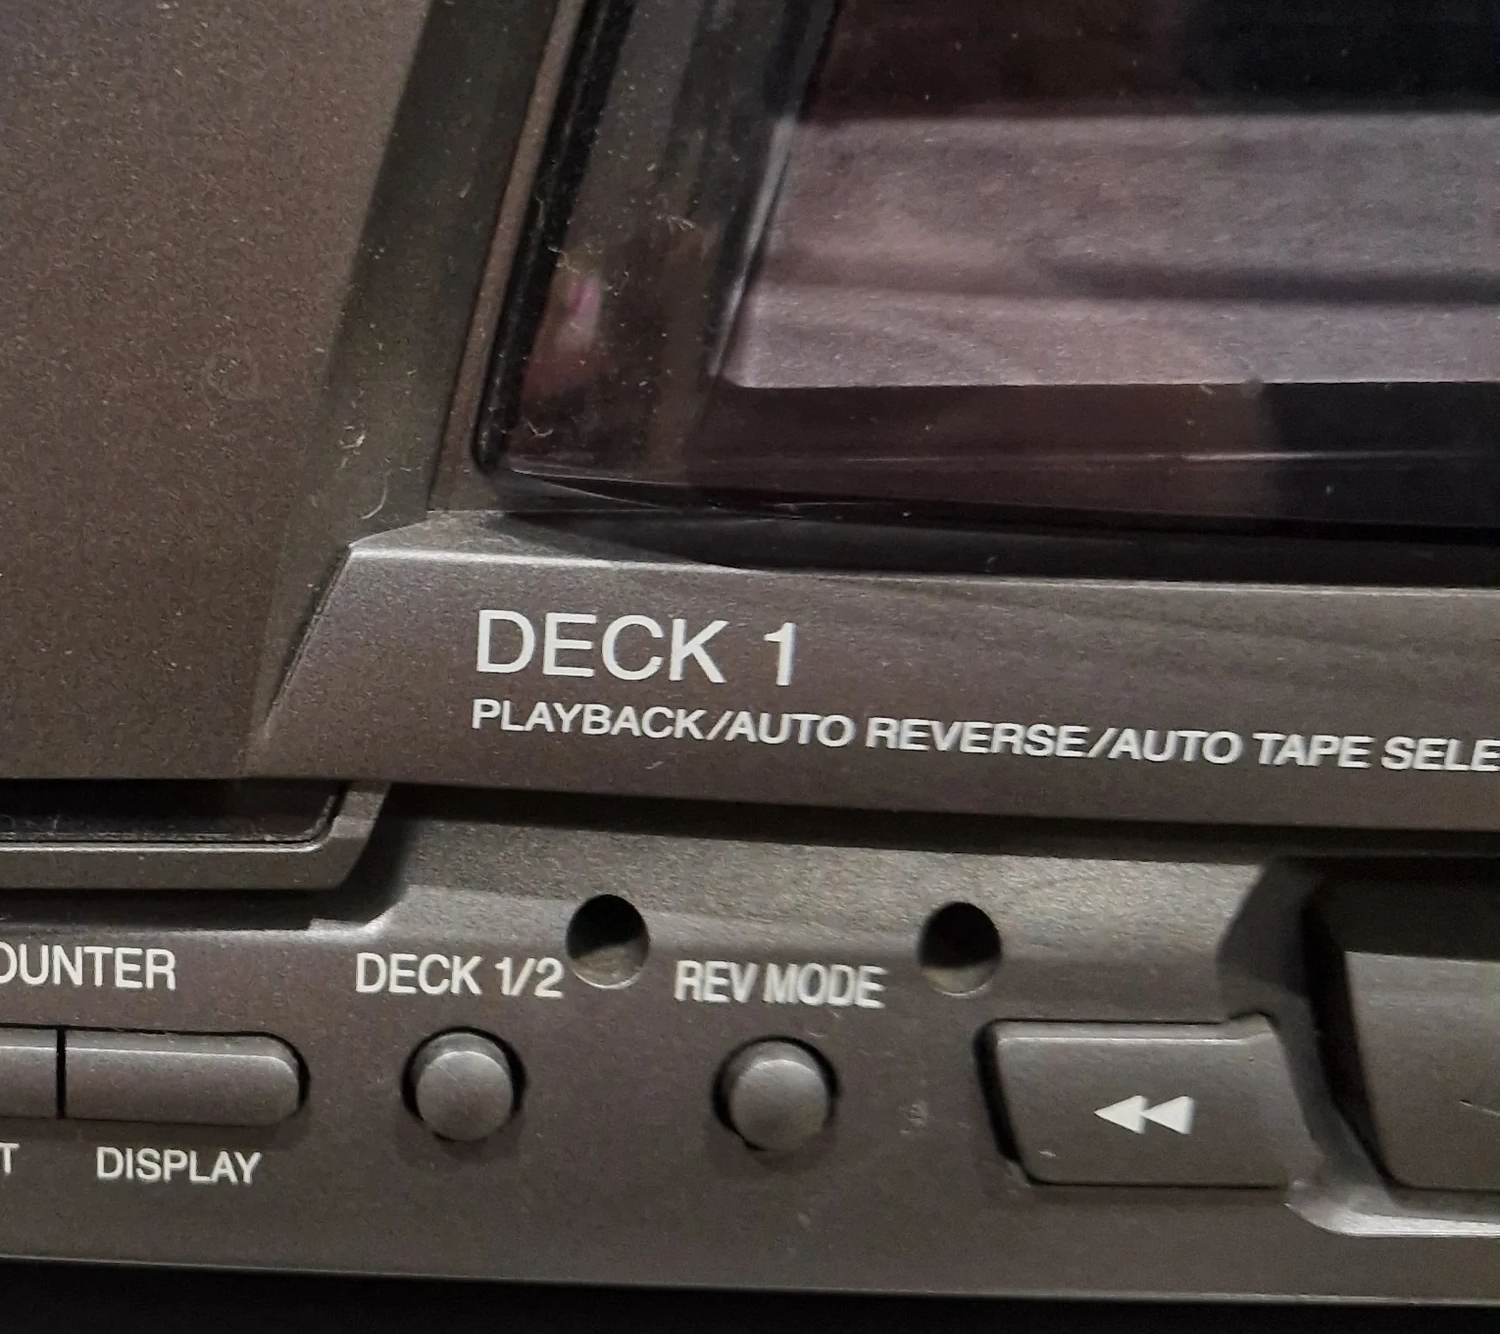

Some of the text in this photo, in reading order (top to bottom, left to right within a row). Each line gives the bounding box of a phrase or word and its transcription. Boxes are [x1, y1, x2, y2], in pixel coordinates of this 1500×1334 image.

[476, 609, 797, 686] DECK 1
[471, 698, 855, 748] PLAYBACK/AUTO
[865, 716, 1244, 765] REVERSE/AUTO
[1252, 731, 1376, 769] TAPE
[355, 951, 565, 1000] DECK 1/2
[674, 959, 888, 1010] REV MODE
[95, 1146, 262, 1187] DISPLAY
